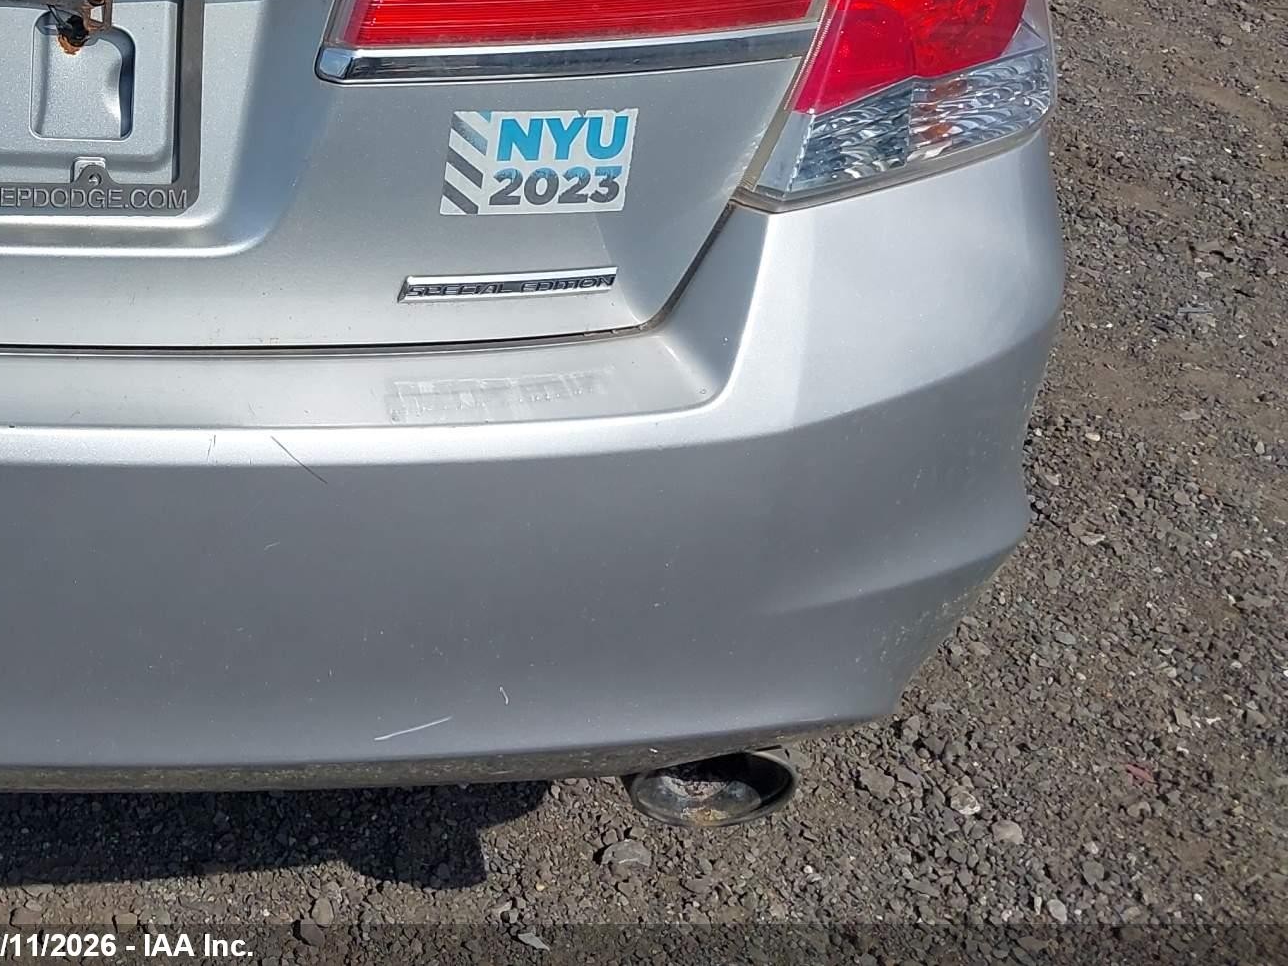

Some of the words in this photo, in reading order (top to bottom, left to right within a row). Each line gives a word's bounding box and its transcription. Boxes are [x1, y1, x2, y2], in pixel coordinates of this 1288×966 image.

[496, 115, 629, 162] NYU
[488, 166, 623, 206] 2023
[407, 280, 513, 297] SPECIAL
[520, 276, 617, 293] EDITION
